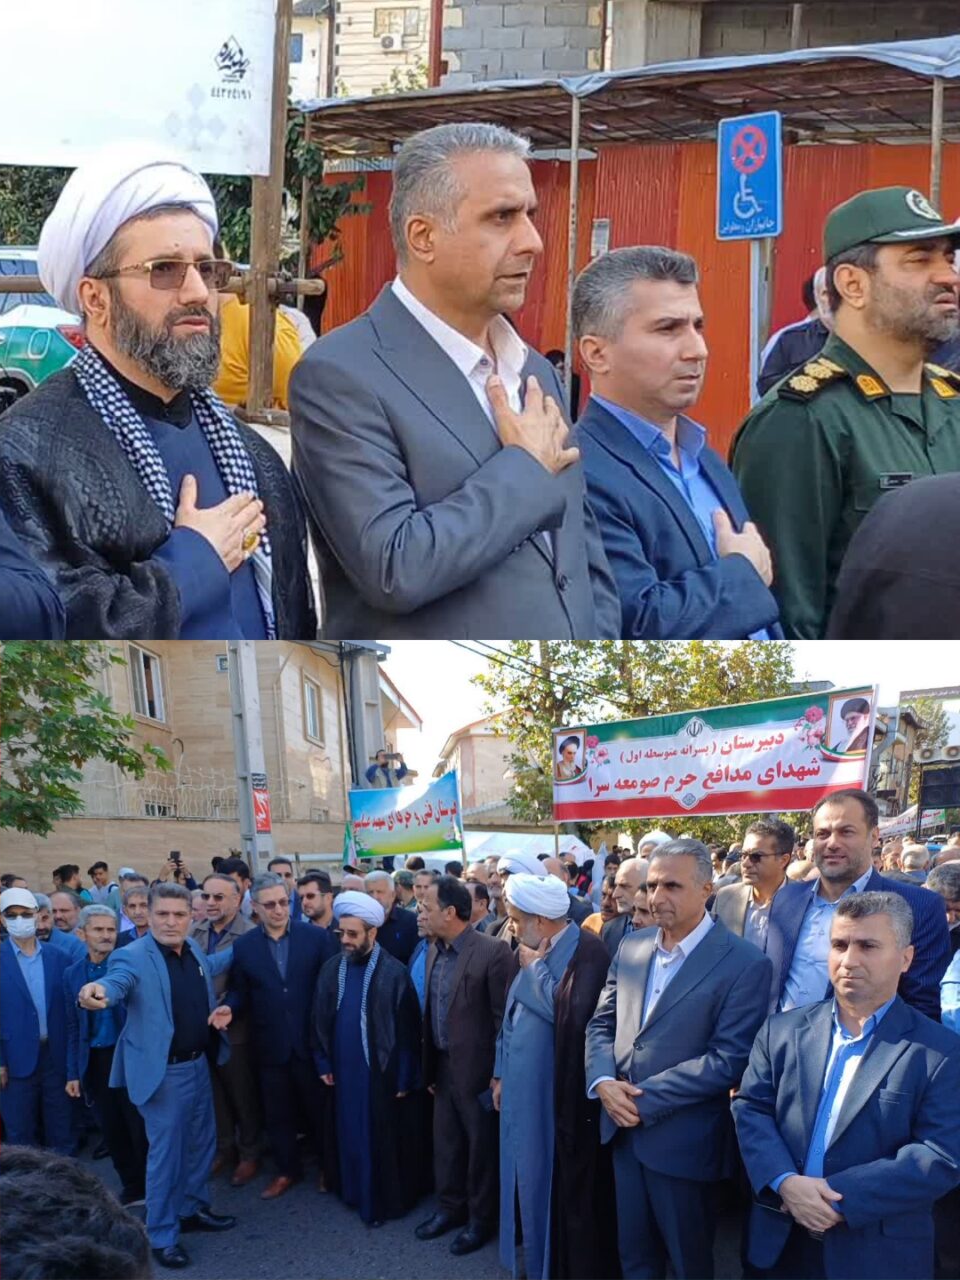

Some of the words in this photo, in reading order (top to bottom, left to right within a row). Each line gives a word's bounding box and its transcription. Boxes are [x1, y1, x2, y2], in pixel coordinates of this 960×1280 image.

[643, 748, 678, 766] متوسطه
[719, 731, 785, 758] دبیرستان
[701, 766, 752, 793] مدافع
[756, 757, 821, 788] شهدای
[586, 778, 613, 798] سرا
[613, 778, 660, 800] صومعه
[662, 773, 699, 799] حرم
